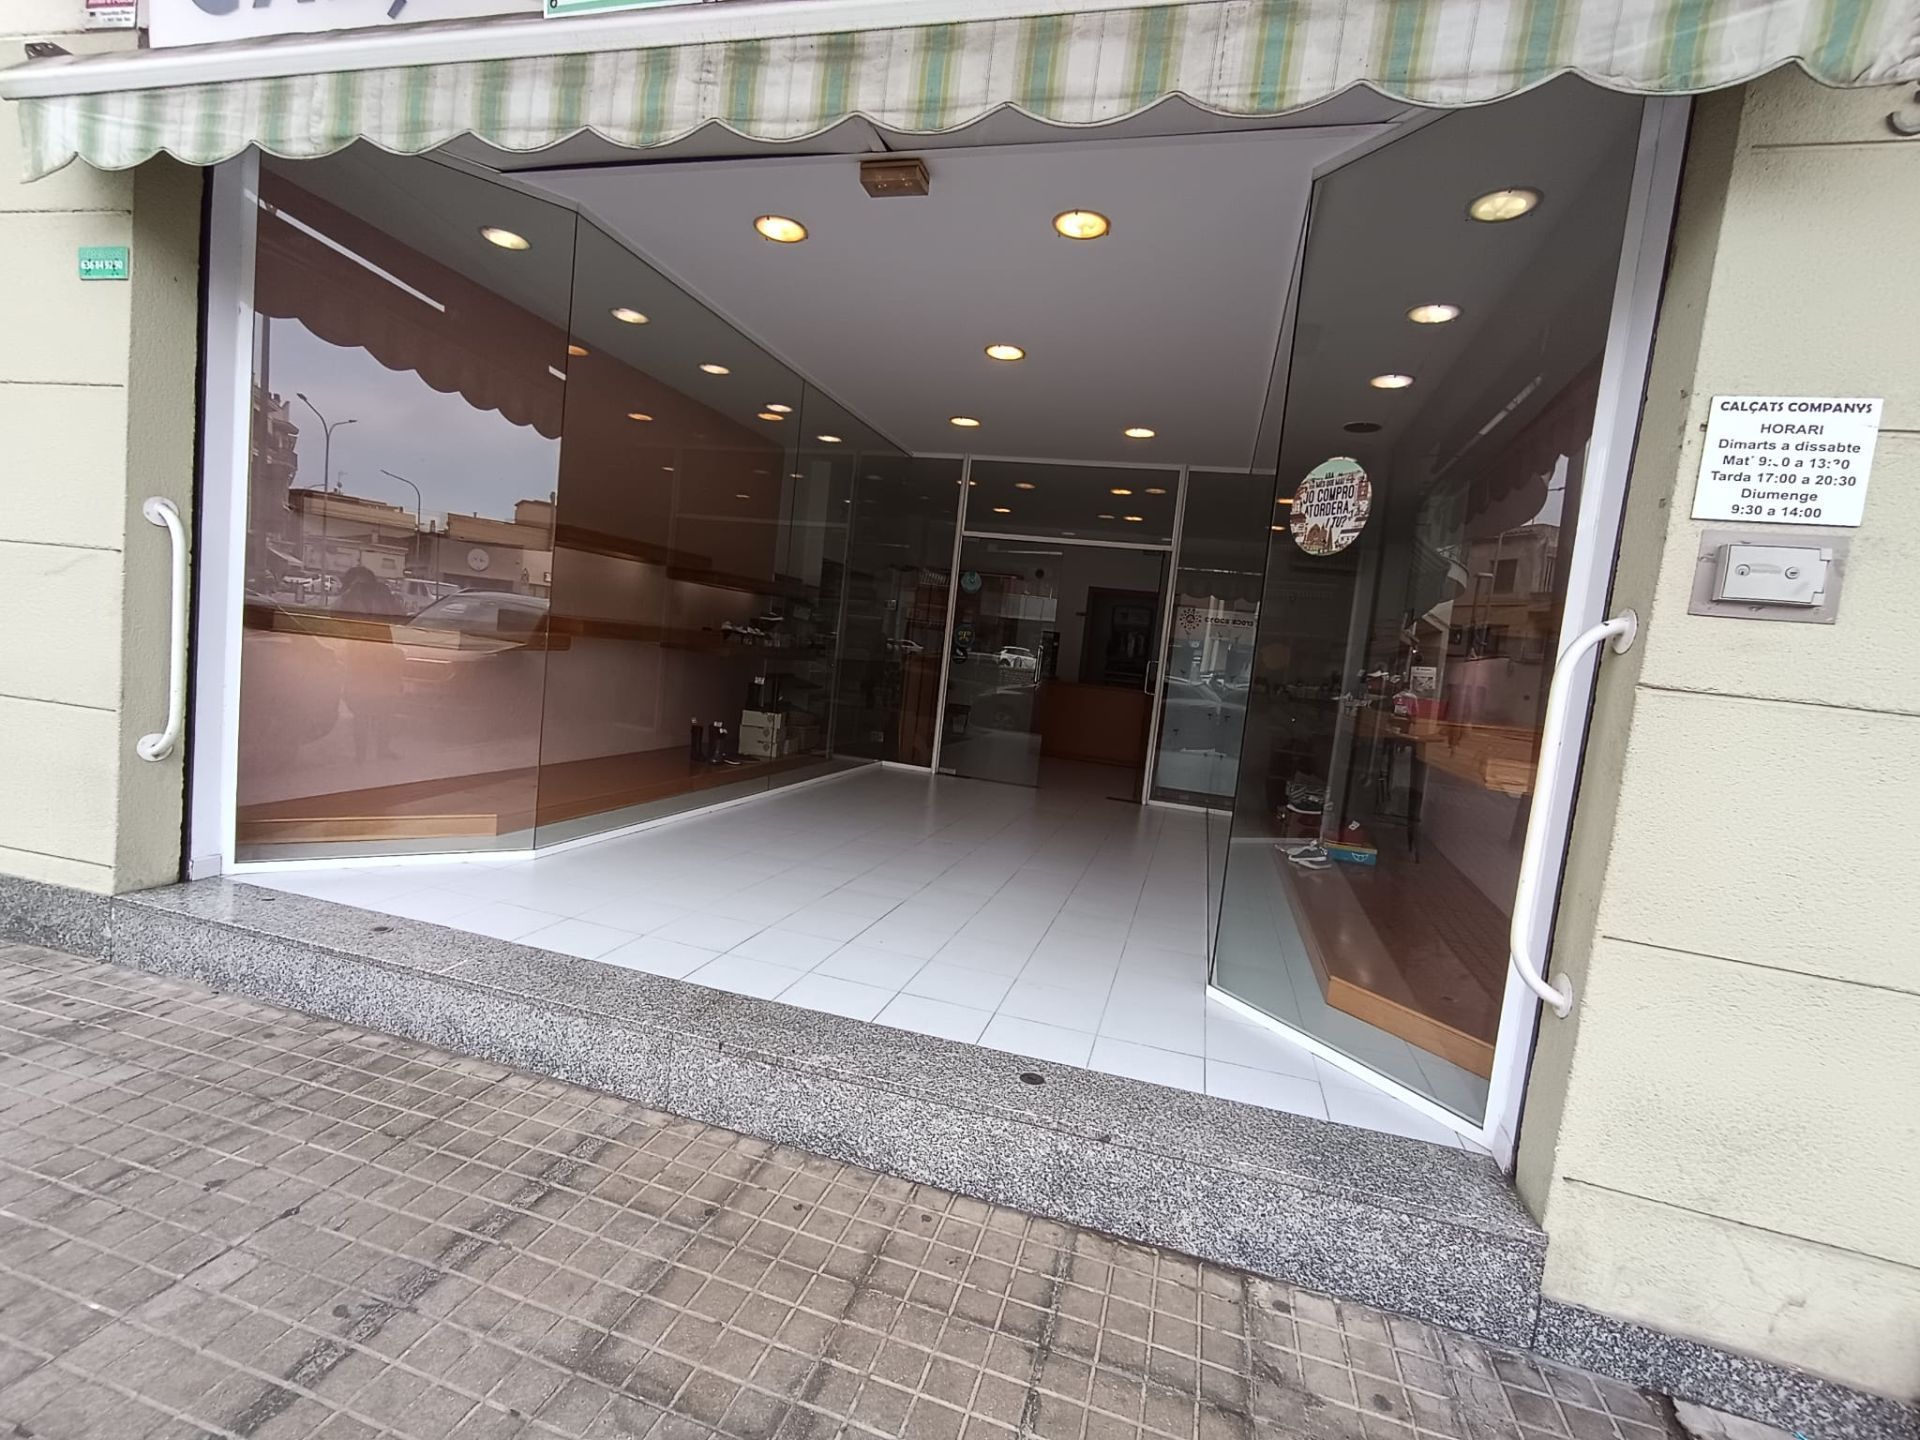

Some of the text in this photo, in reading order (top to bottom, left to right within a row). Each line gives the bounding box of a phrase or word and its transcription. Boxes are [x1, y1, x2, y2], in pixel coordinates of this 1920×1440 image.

[1720, 401, 1872, 414] CALÇATS COMPANYS
[1760, 423, 1824, 435] HORARI
[1718, 439, 1861, 453] Dimarts a dissabte
[1758, 456, 1790, 467] 9:0
[1794, 459, 1803, 468] a
[1711, 470, 1856, 486] Tarda 17:00 a 20:30
[1303, 485, 1355, 505] JO COMPRO
[1741, 488, 1818, 503] Diumenge
[1731, 504, 1822, 518] 9:30 a 14:00
